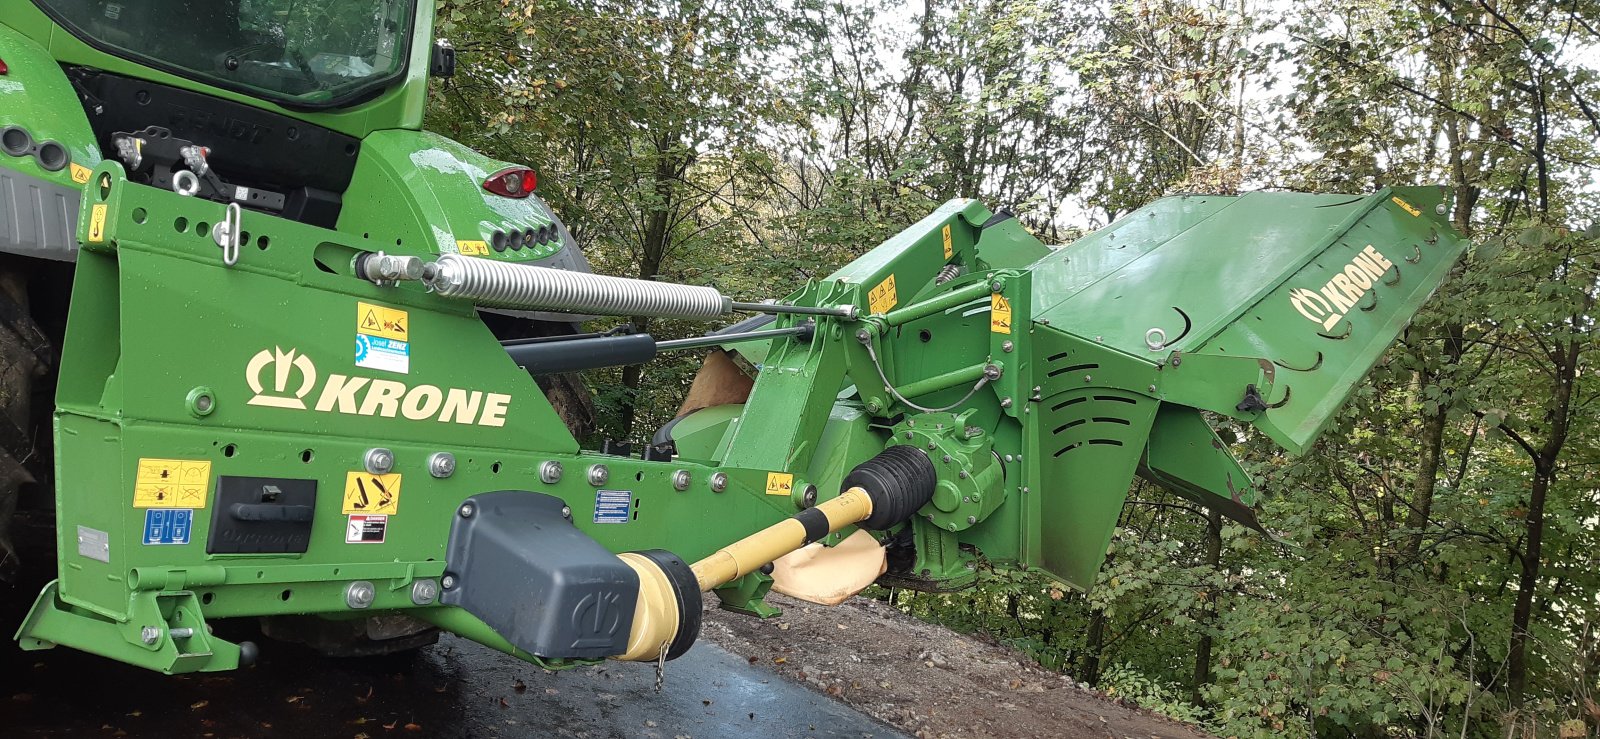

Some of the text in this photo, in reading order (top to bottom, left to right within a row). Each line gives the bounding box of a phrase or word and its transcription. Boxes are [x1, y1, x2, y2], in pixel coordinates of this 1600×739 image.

[1320, 244, 1393, 315] KRONE
[387, 339, 407, 351] ZENZ
[314, 374, 511, 427] KRONE
